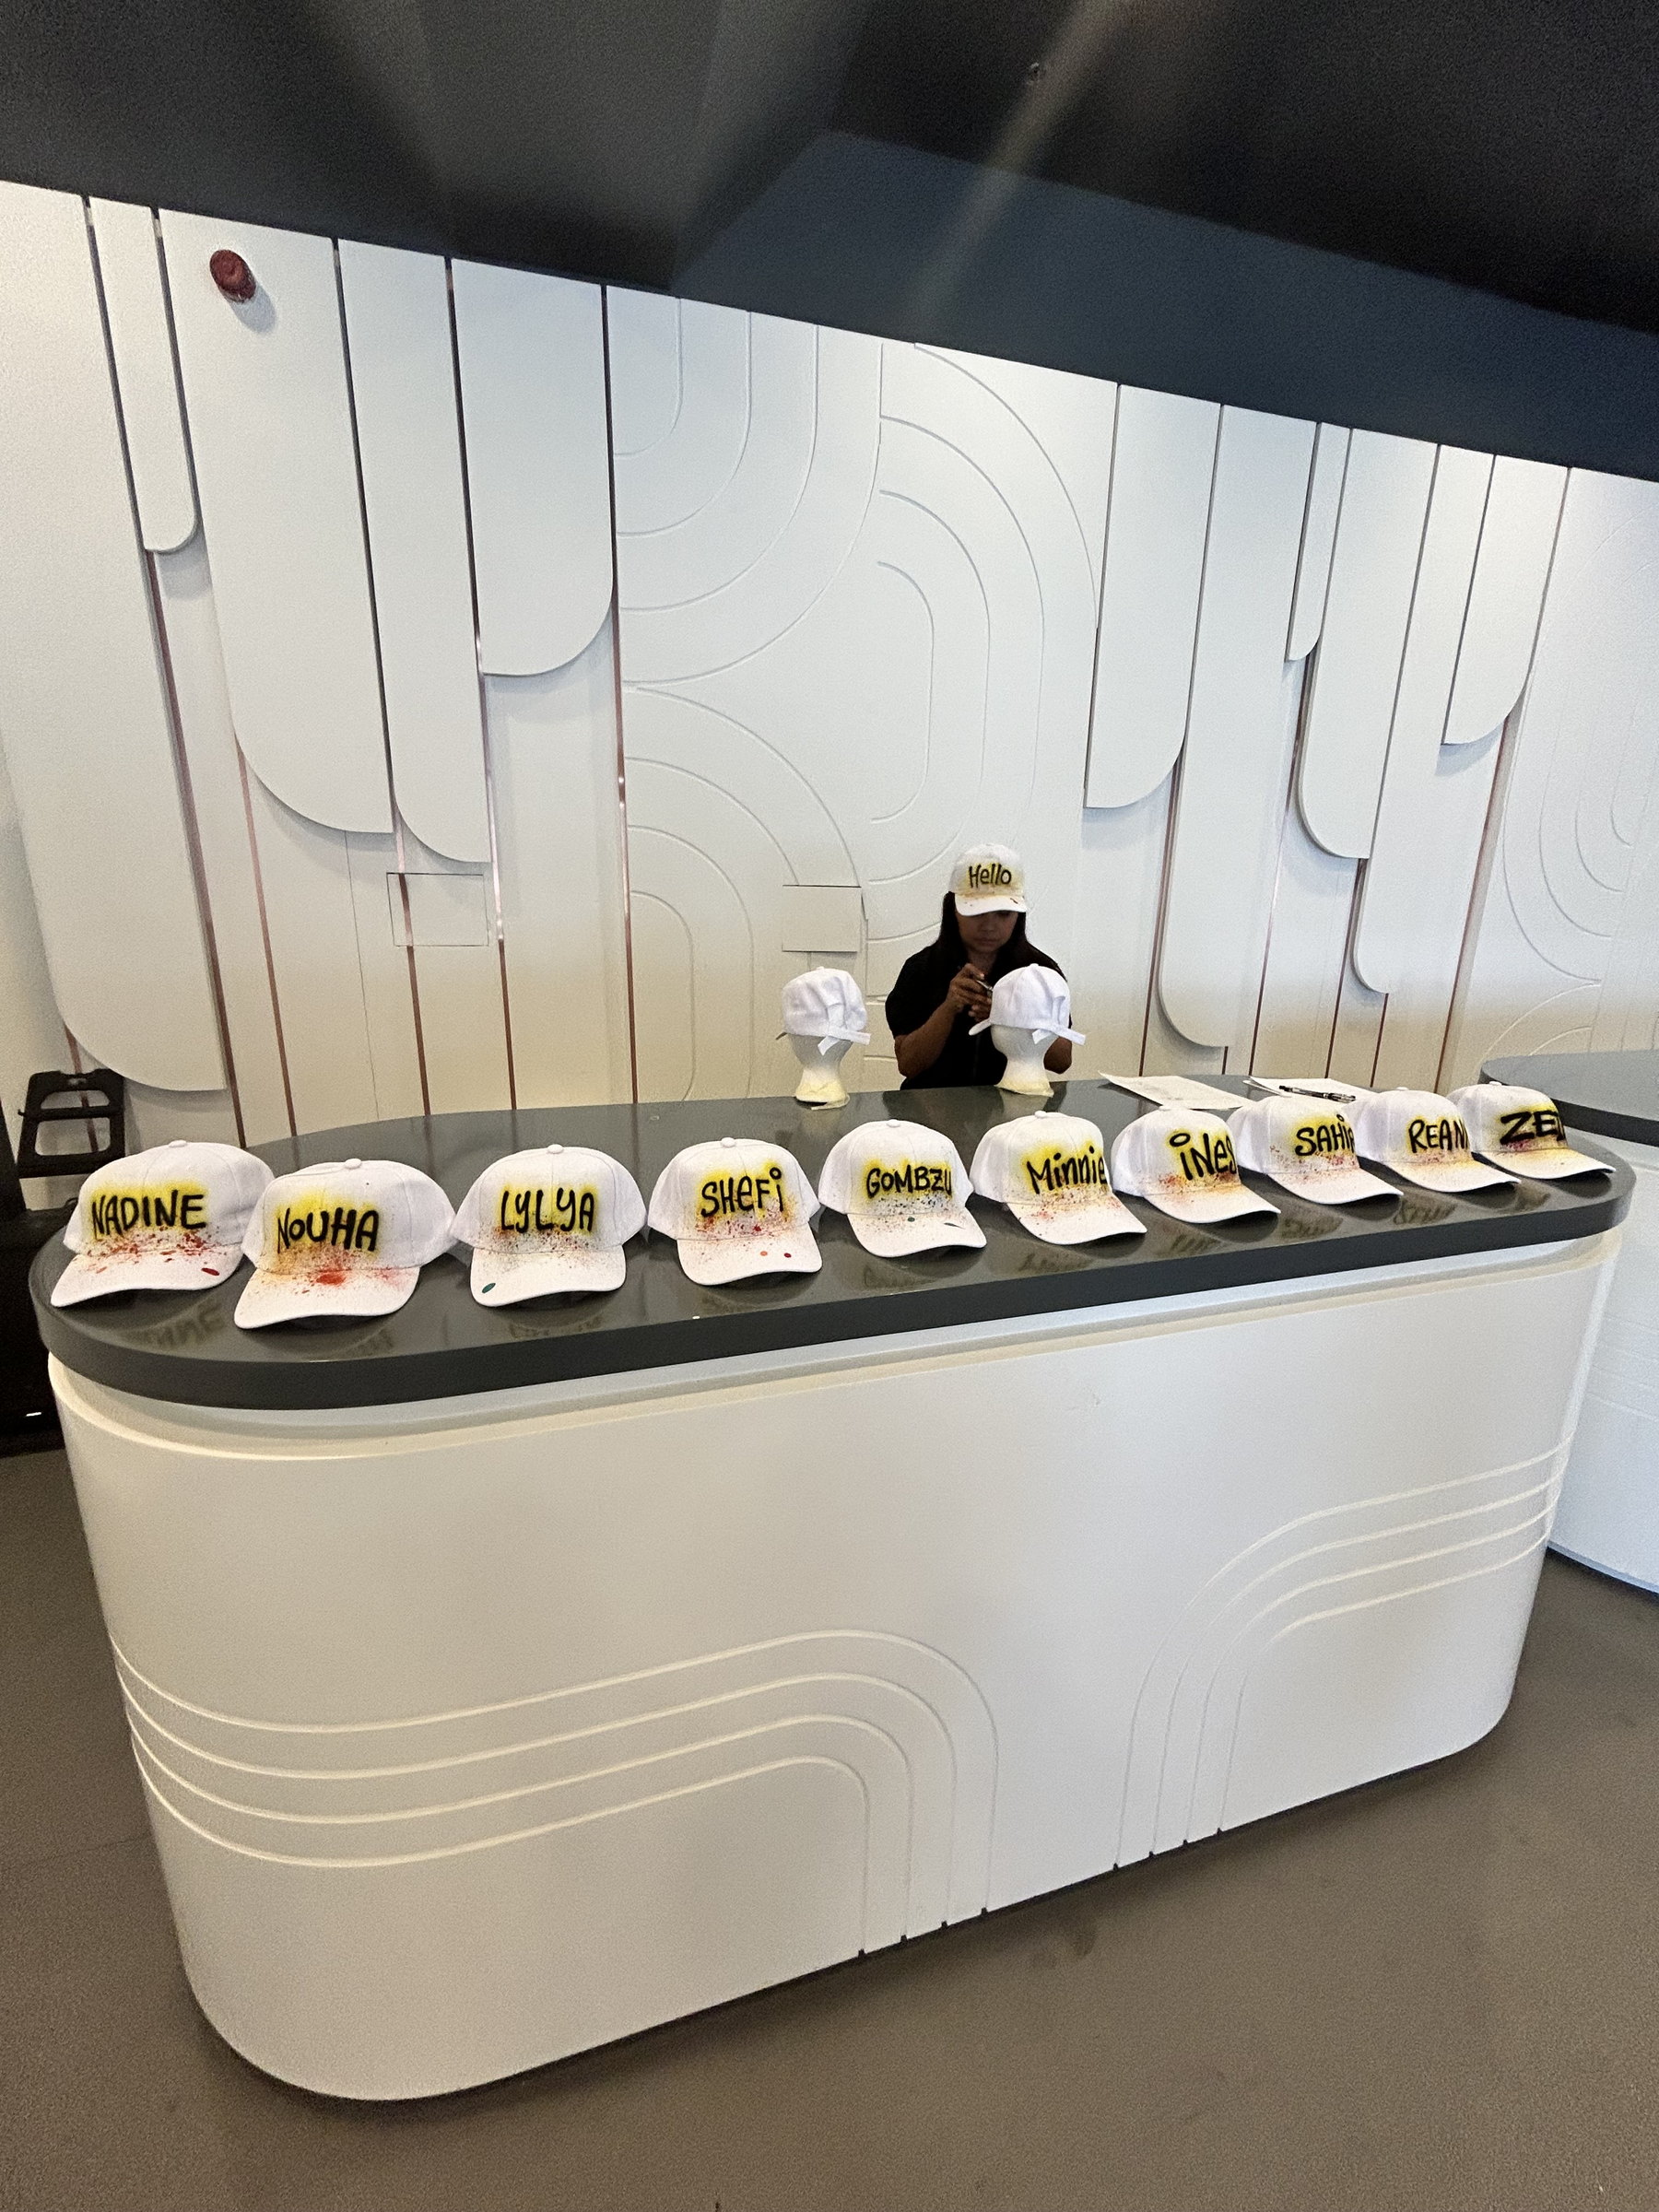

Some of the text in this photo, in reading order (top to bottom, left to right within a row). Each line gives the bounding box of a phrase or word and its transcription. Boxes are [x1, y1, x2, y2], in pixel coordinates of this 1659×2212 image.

[969, 863, 1012, 888] Hello
[1026, 1145, 1108, 1194] Minnie
[92, 1189, 206, 1241] NADINE
